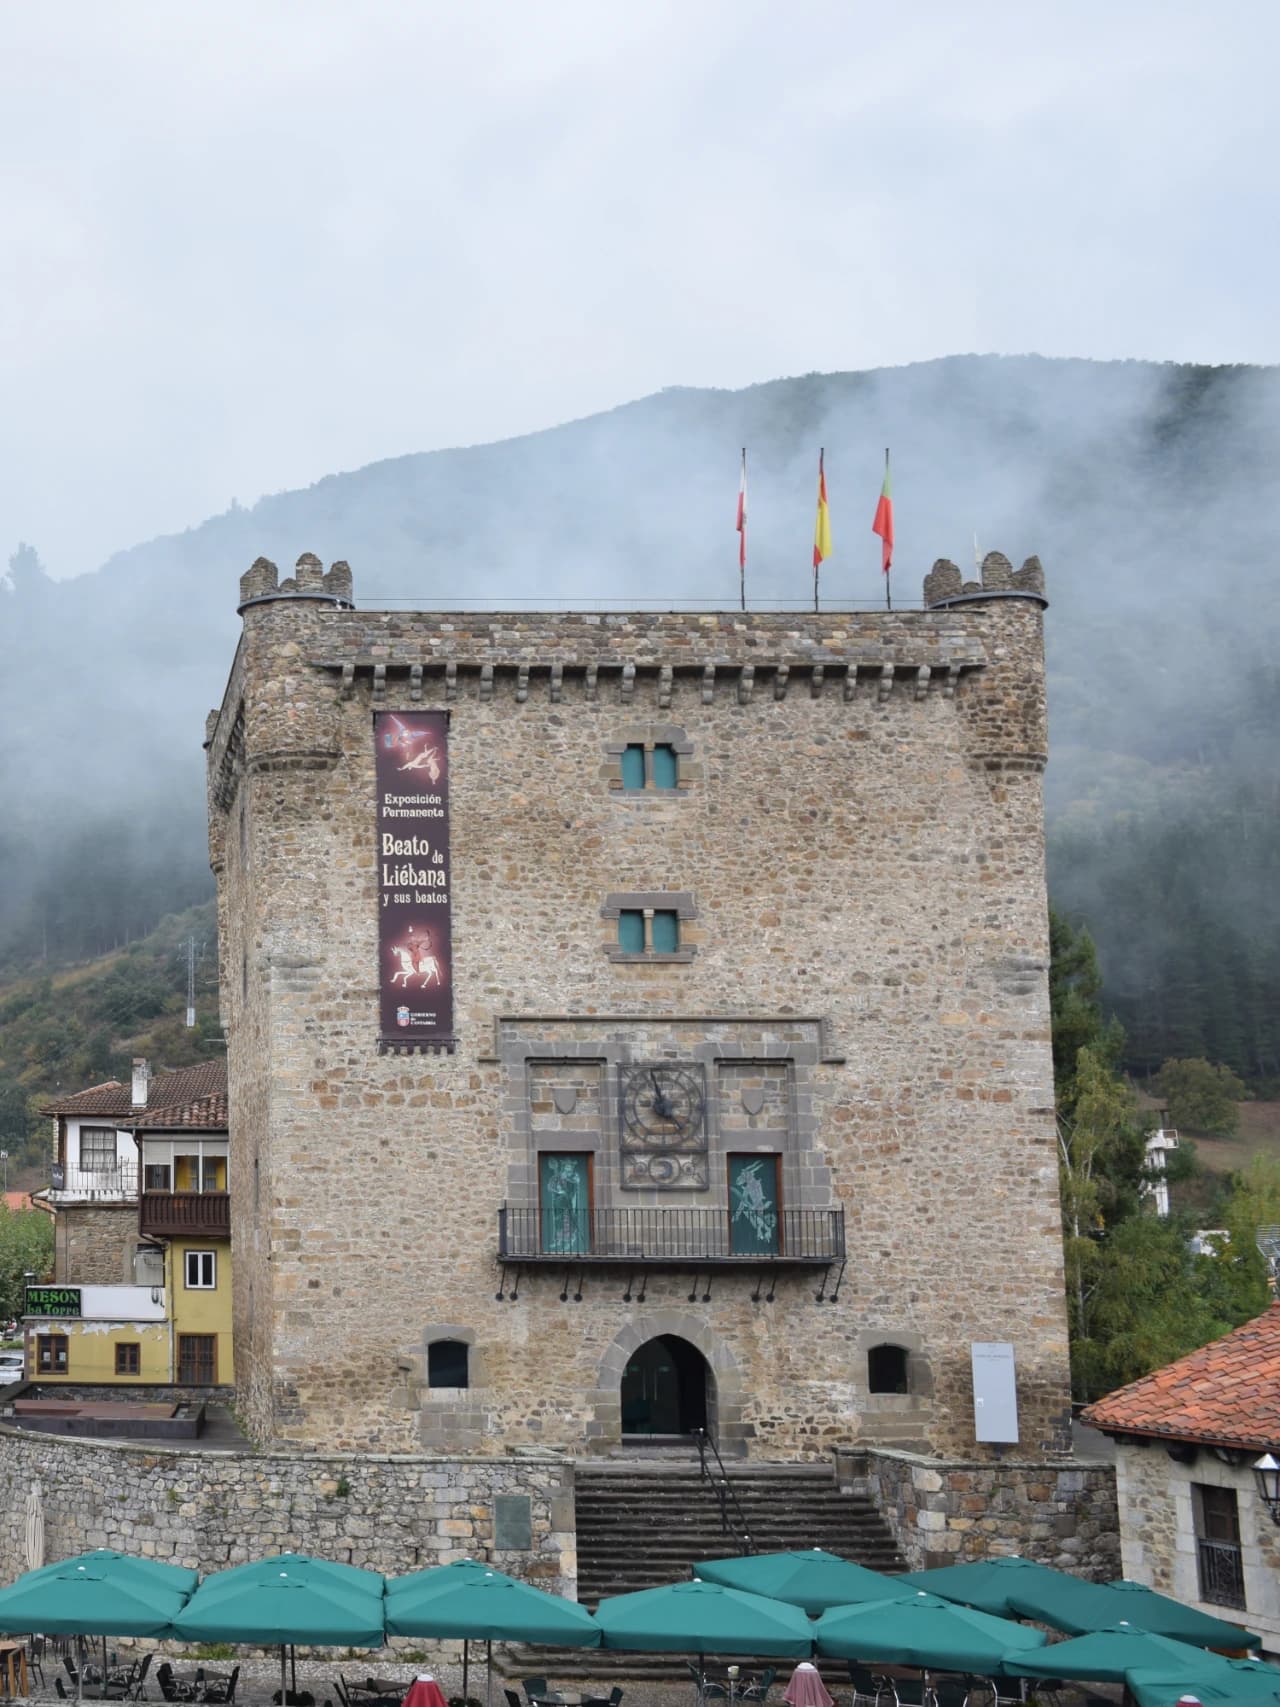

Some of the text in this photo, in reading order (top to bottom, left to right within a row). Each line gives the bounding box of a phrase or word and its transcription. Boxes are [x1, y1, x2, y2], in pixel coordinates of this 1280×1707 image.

[384, 793, 442, 807] Exposición
[382, 806, 445, 818] Permanente
[382, 832, 444, 864] Beato de
[382, 863, 446, 888] Liébana
[383, 890, 448, 907] y sus beatos
